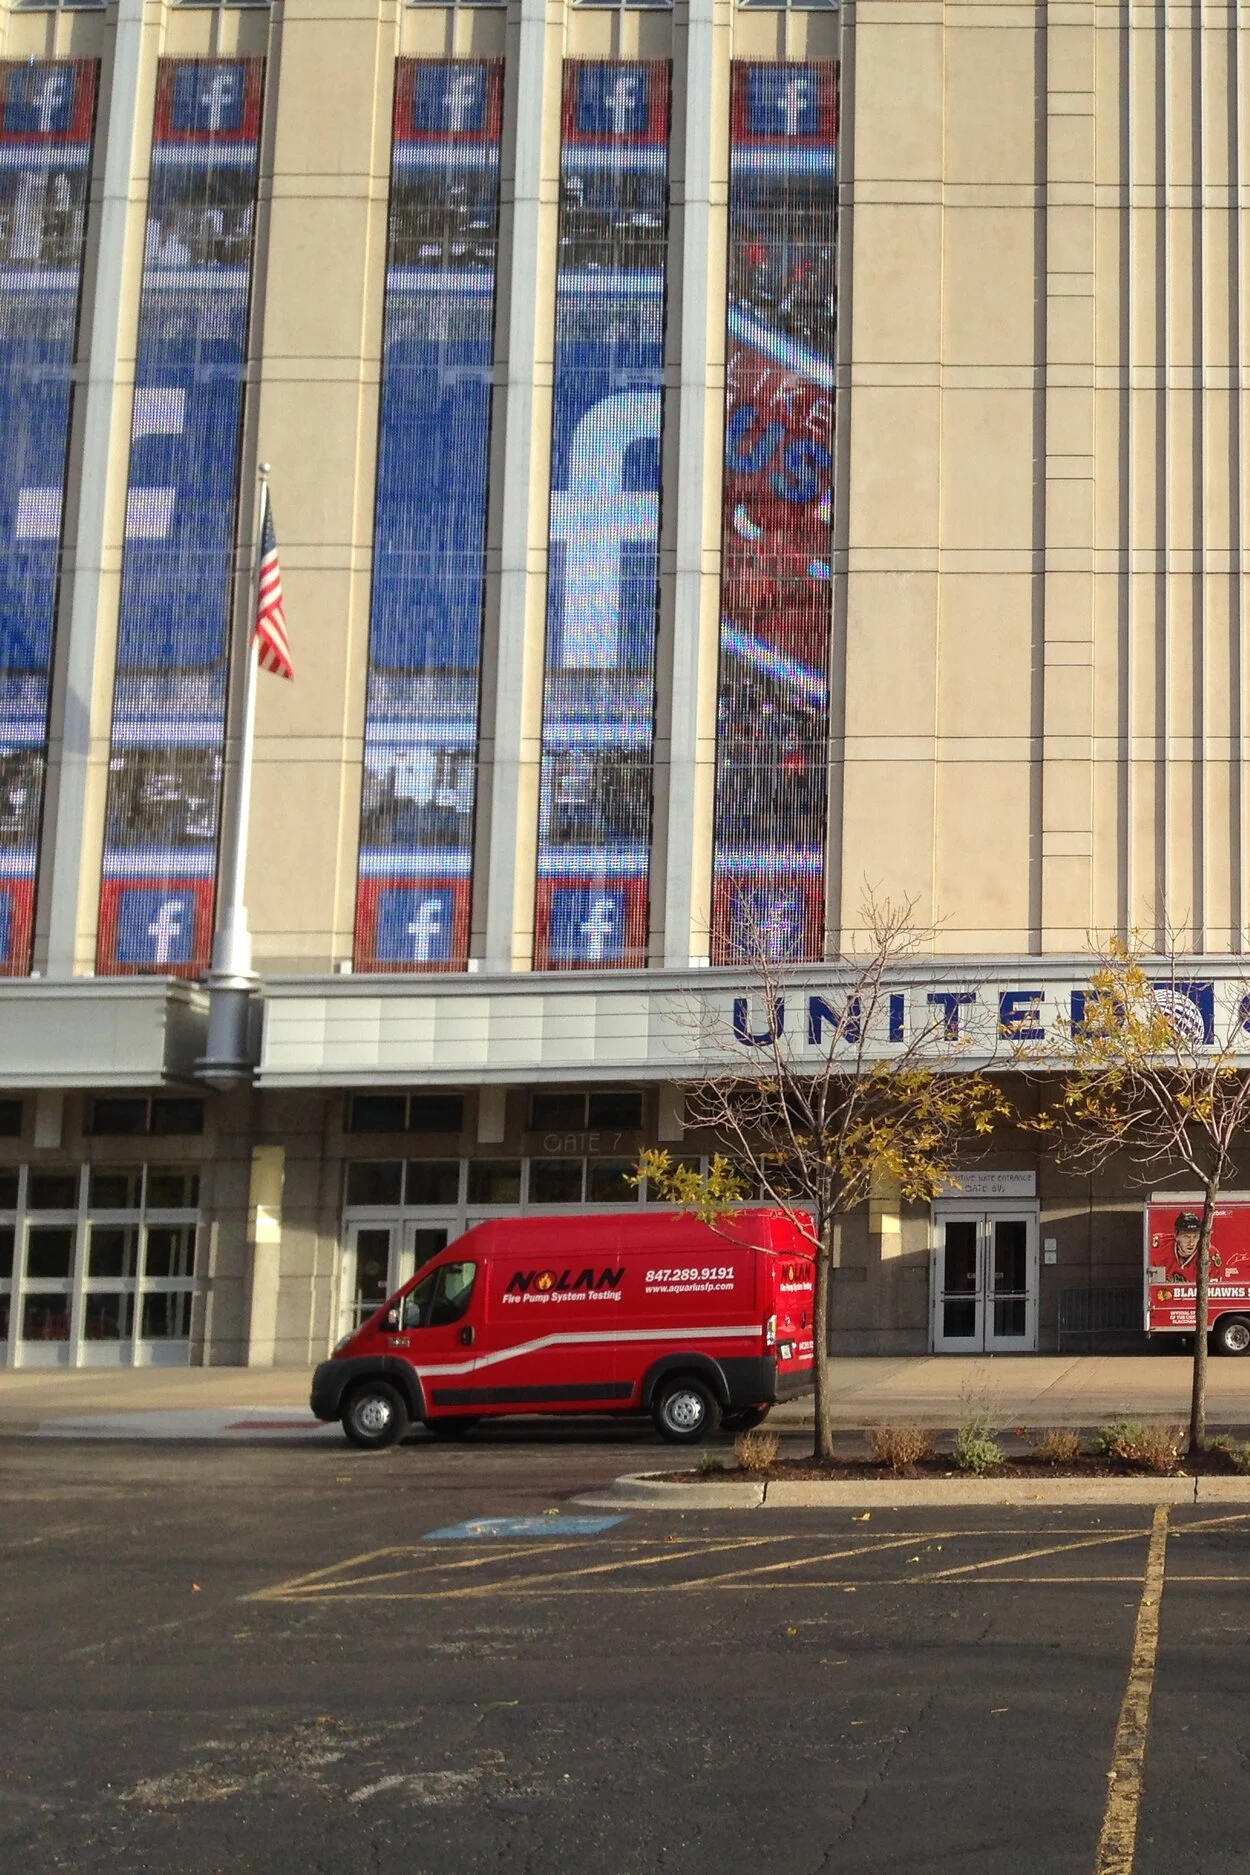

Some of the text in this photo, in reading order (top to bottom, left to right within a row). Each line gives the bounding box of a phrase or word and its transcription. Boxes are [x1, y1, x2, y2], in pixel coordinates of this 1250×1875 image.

[733, 990, 1124, 1047] UNITED
[543, 1132, 622, 1152] GATE 7
[505, 1267, 626, 1293] NOLAN
[645, 1267, 735, 1282] 847.289.9191
[645, 1282, 734, 1293] www.aquariusfp.com
[502, 1290, 621, 1304] Fire Pump System Testing
